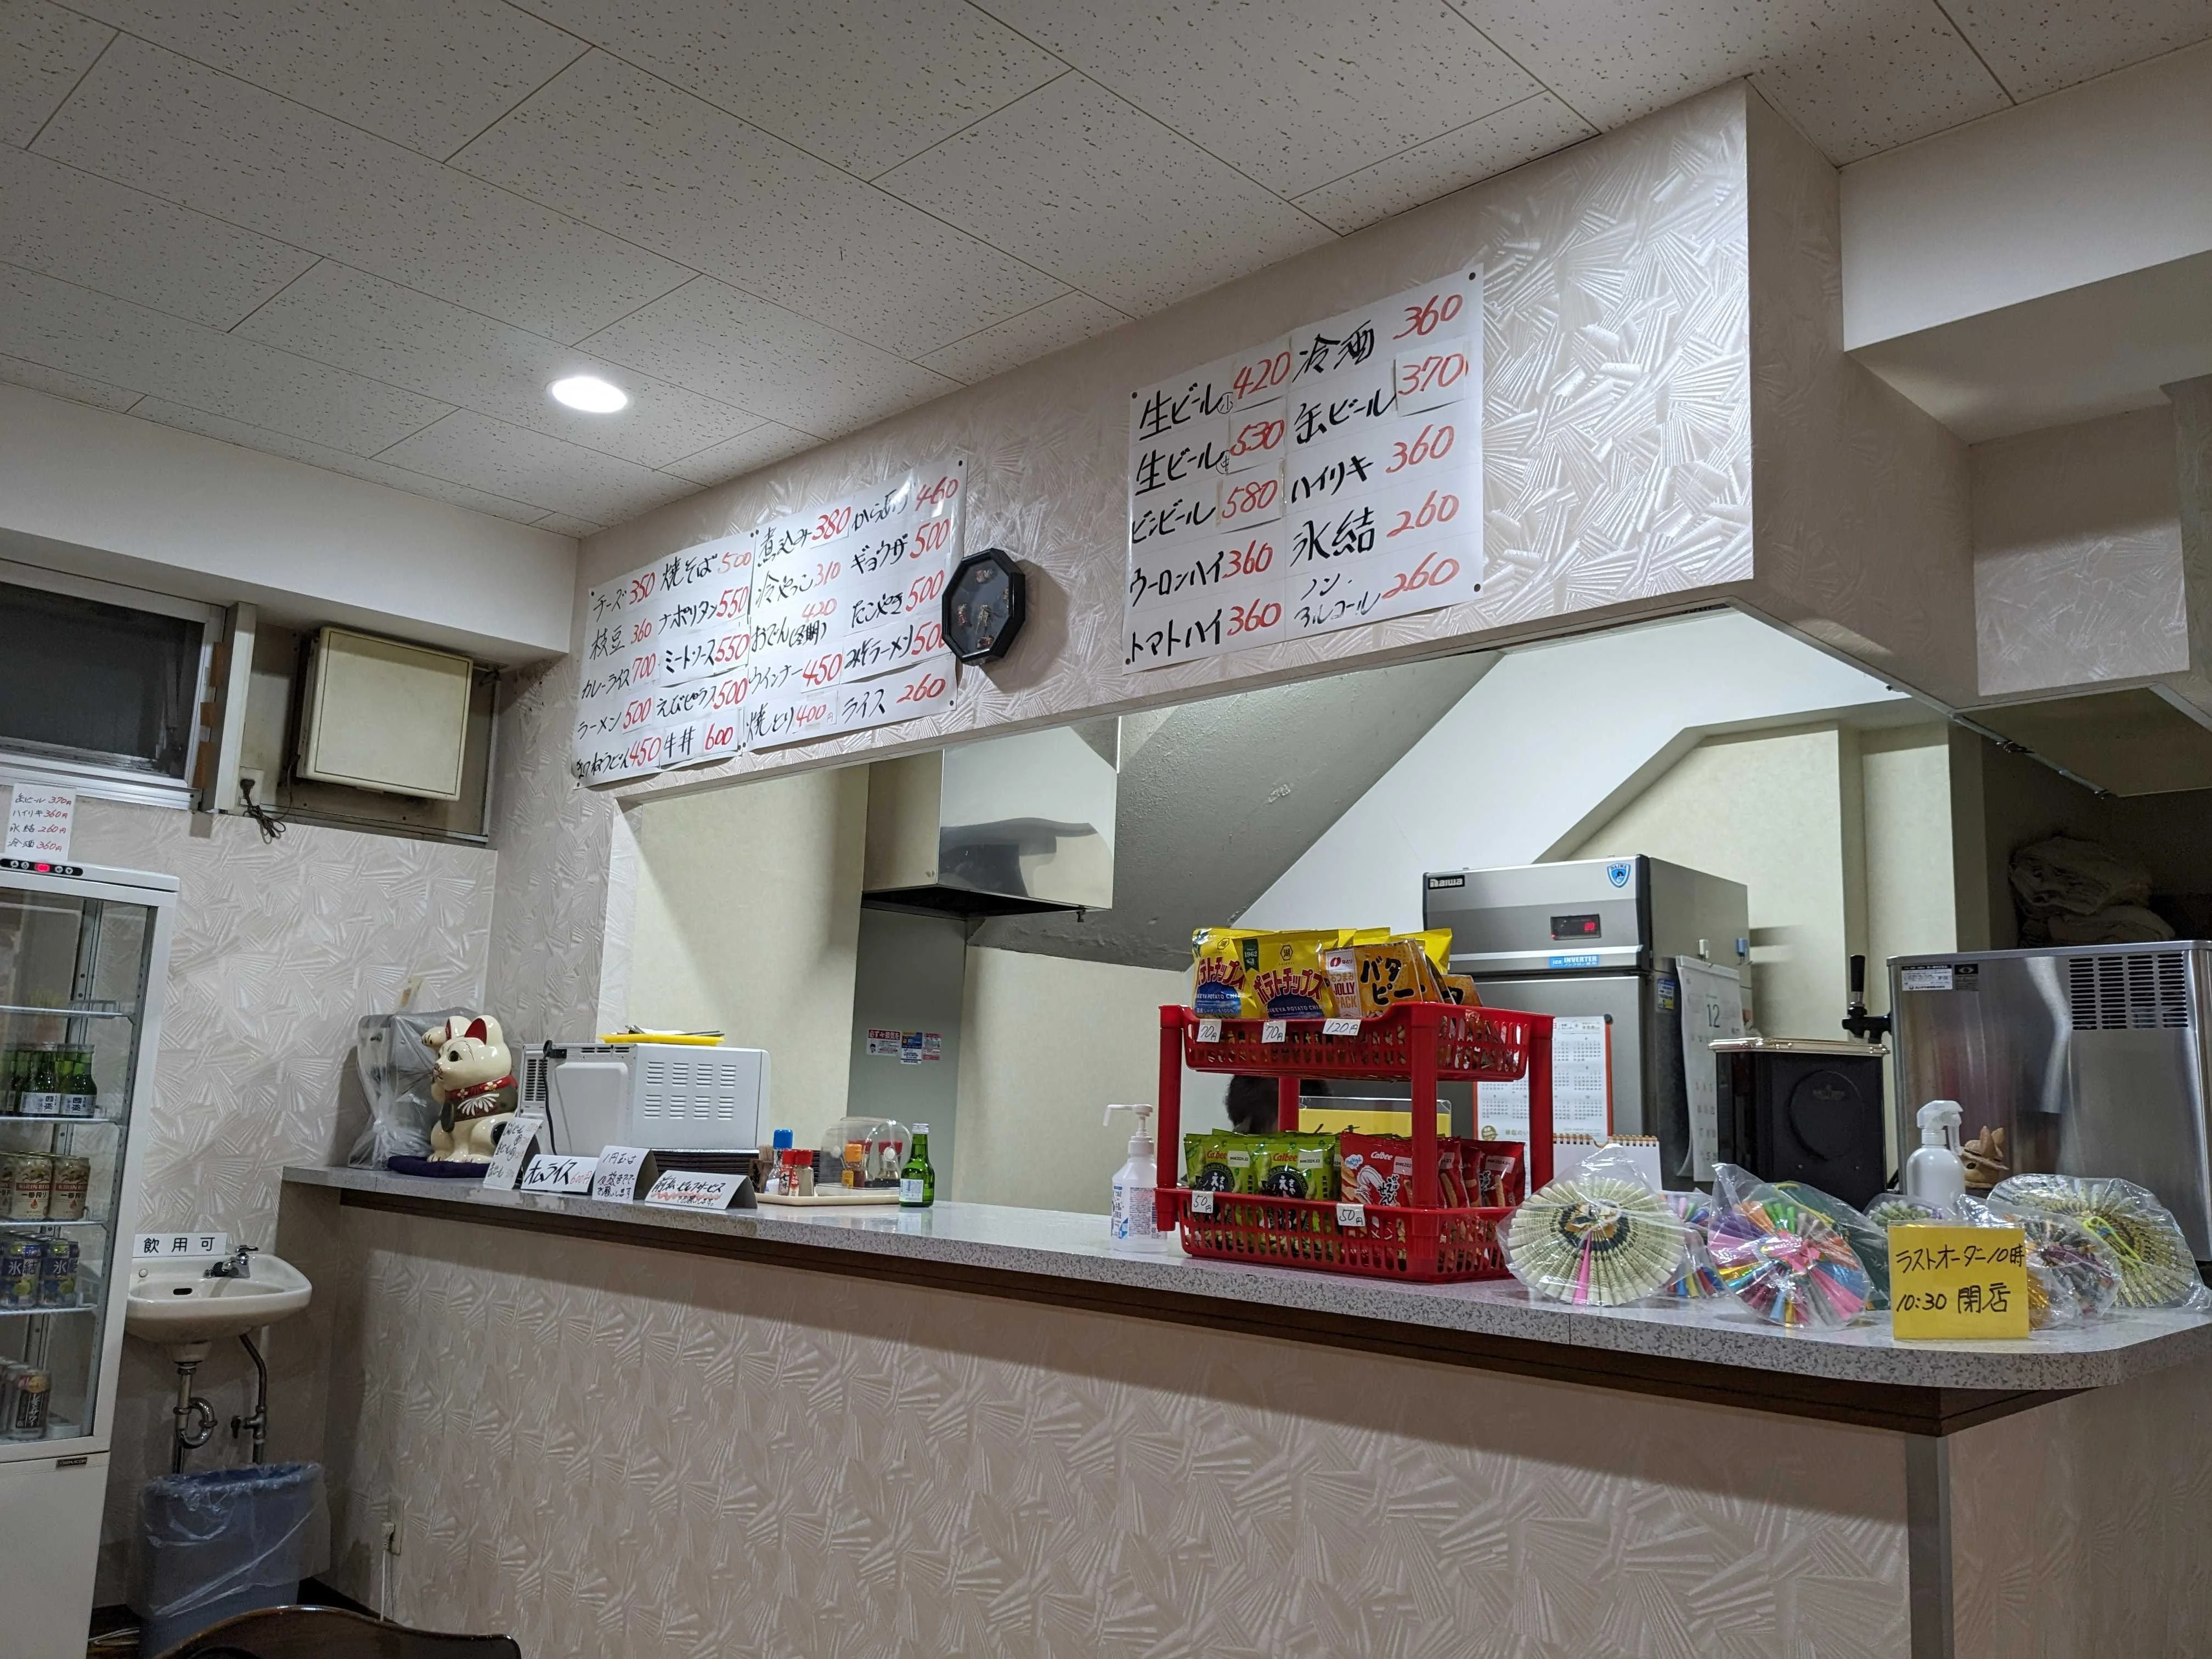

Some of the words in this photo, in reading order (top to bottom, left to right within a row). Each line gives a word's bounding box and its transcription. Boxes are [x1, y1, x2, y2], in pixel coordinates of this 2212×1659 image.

[1393, 294, 1463, 340] 360
[1233, 351, 1291, 399] 420
[1397, 352, 1464, 396] 370
[1229, 418, 1285, 457] 530
[1291, 454, 1373, 504] ハイリキ
[1385, 424, 1455, 474] 360
[915, 476, 959, 512] 460
[1221, 479, 1278, 520] 580
[811, 506, 851, 543] 380
[1289, 506, 1375, 568] 氷結
[1386, 489, 1459, 539] 260
[850, 533, 909, 574] ギョウザ
[910, 518, 950, 560] 500
[660, 556, 717, 592] 焼そば
[718, 551, 751, 573] 500
[813, 560, 841, 588] 310
[1130, 550, 1225, 607] ウーロンハイ
[1222, 540, 1273, 579] 360
[1294, 591, 1382, 628] アルコール
[1382, 551, 1460, 600] 260
[593, 588, 626, 622] チーズ
[629, 572, 656, 605] 350
[658, 601, 717, 635] ナポリタン
[716, 585, 749, 618] 550
[802, 598, 837, 621] 420
[852, 592, 904, 629] たこやき
[905, 569, 945, 612] 500
[589, 626, 624, 662] 枝豆
[630, 619, 652, 645] 360
[1130, 608, 1221, 662] トマトハイ
[1227, 600, 1282, 636] 360
[665, 639, 715, 674] ミートソース
[714, 633, 750, 662] 550
[582, 668, 629, 699] カレーライス
[631, 652, 656, 685] 700
[749, 664, 804, 695] ウインナー
[802, 653, 842, 687] 450
[657, 685, 716, 719] えびピラフ
[713, 676, 748, 710] 500
[842, 689, 885, 723] ライス
[896, 673, 946, 704] 260
[577, 712, 623, 740] ラーメン
[622, 697, 653, 730] 500
[746, 701, 794, 741] 焼とり
[629, 737, 662, 768] 450
[704, 724, 733, 751] 600
[13, 809, 43, 817] ハイリキ
[43, 810, 68, 819] 360円
[48, 796, 72, 806] 370円
[36, 841, 62, 852] 360円
[38, 824, 66, 834] 260円
[1253, 967, 1325, 1005] ポテトチップス
[1334, 983, 1355, 995] JOLLY
[1200, 1025, 1217, 1041] 70円
[1266, 1026, 1284, 1041] 70円
[1327, 1022, 1358, 1033] 120円
[1707, 1004, 1720, 1028] 12
[524, 1159, 577, 1185] オムライス
[1207, 1149, 1228, 1159] Calbee
[1272, 1152, 1298, 1162] Calbee
[1370, 1151, 1394, 1161] Calbee
[597, 1187, 631, 1199] お願いします
[1193, 1195, 1212, 1212] 50円
[1339, 1209, 1363, 1225] 50円
[144, 1237, 216, 1254] 飲用可
[1894, 1244, 2024, 1273] ラストオーダー10時
[1895, 1293, 1947, 1313] 10:30
[1957, 1282, 2011, 1314] 閉店
